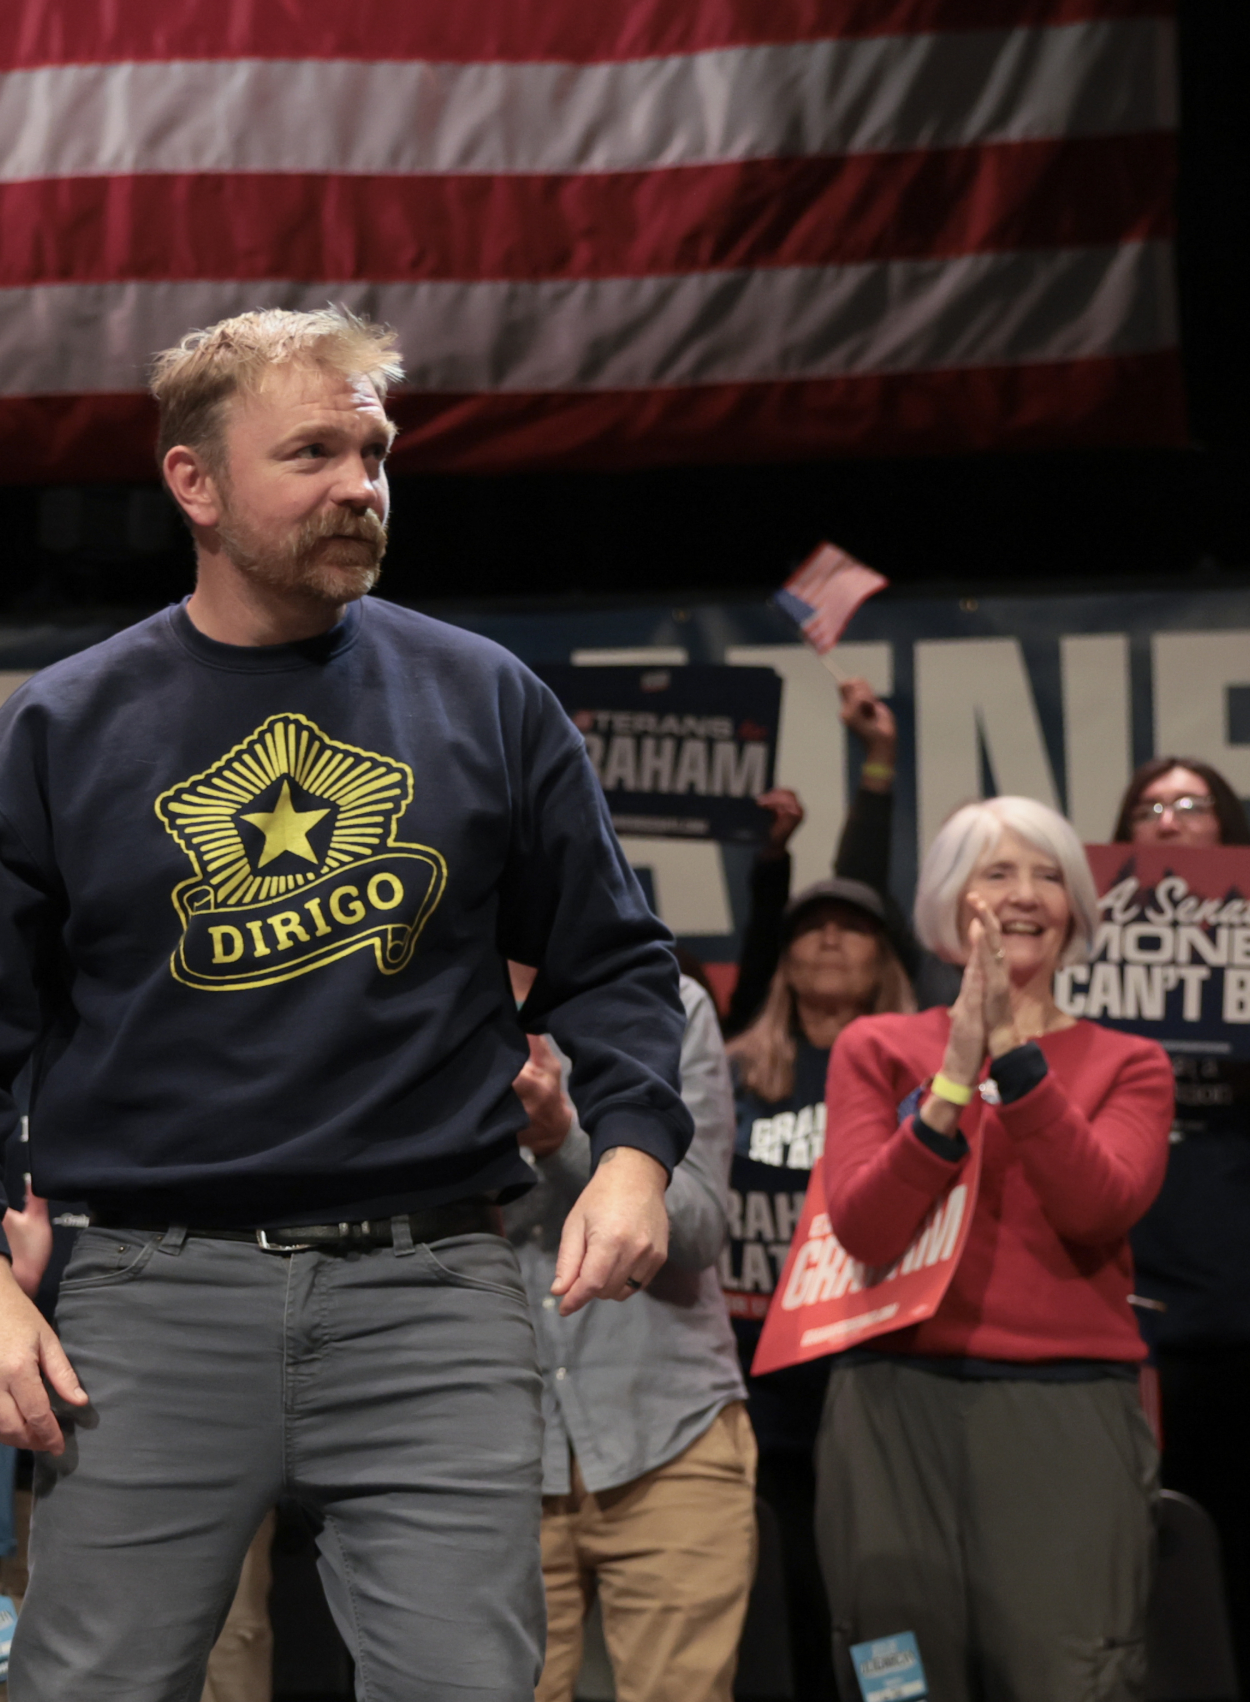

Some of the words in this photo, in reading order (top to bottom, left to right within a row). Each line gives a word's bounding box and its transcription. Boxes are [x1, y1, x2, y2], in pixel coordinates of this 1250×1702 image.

[207, 872, 404, 964] DIRIGO
[1145, 876, 1250, 926] Sena
[1053, 961, 1211, 1022] CAN'T
